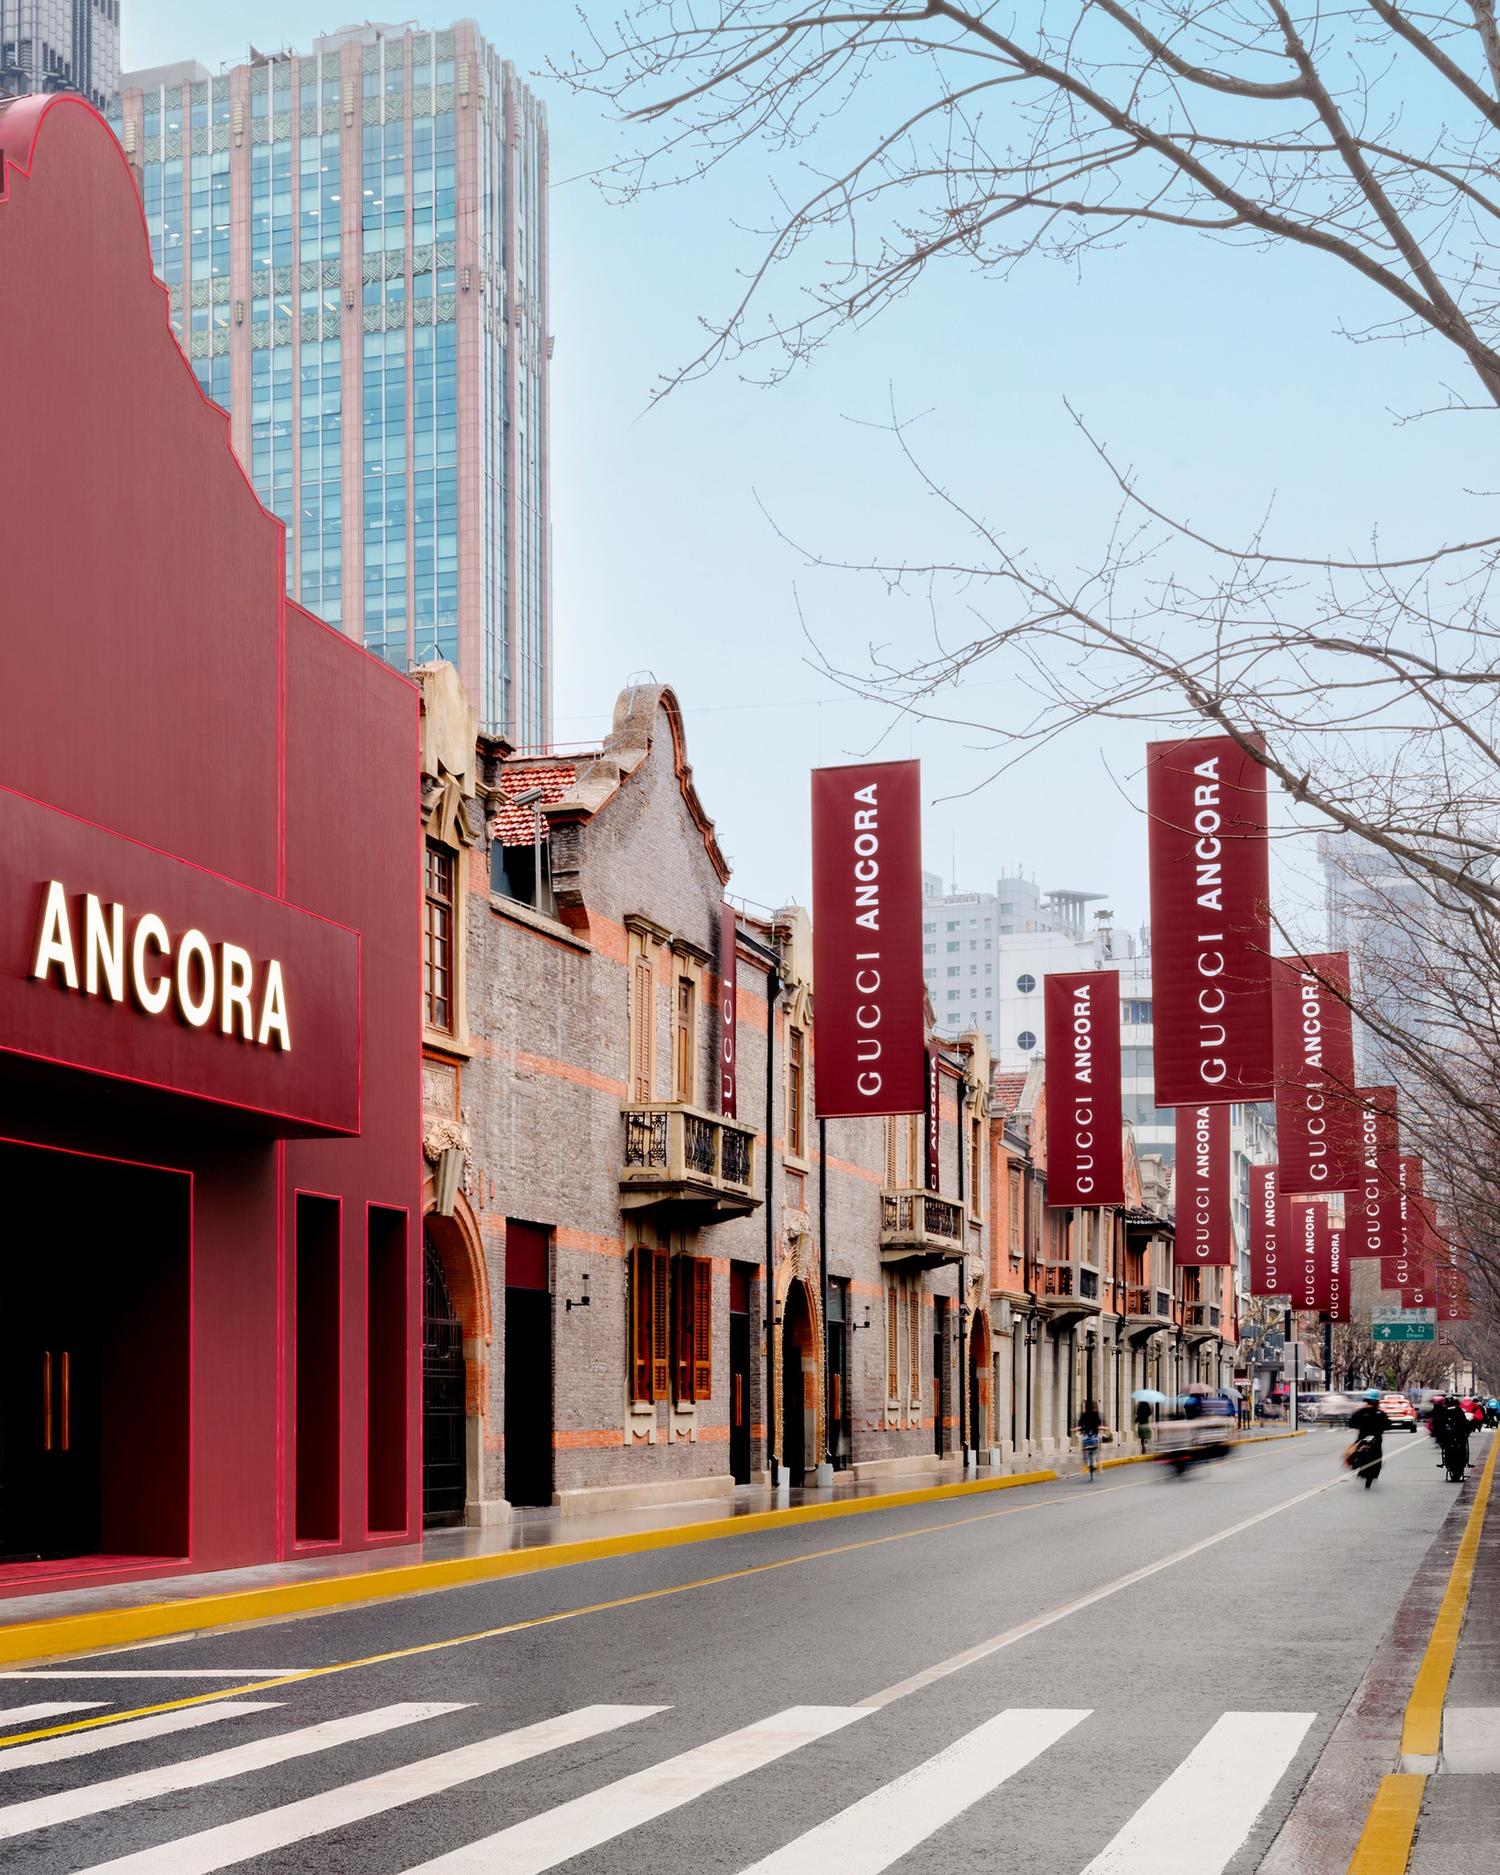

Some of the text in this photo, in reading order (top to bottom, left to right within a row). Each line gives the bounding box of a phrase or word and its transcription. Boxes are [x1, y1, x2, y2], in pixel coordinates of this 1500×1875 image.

[34, 880, 291, 1051] ANCORA
[854, 783, 882, 1096] GUCCI ANCORA
[1194, 756, 1227, 1084] GUCCI ANCORA
[723, 979, 733, 1120] UCCI
[1073, 985, 1094, 1193] GUCCI ANCORA
[1196, 1106, 1210, 1257] GUCCI ANCORA
[1306, 1083, 1328, 1181] GUCCI
[1265, 1171, 1277, 1289] GUCCI ANCORA
[1305, 1207, 1315, 1305] GUCCI ANCORA
[1330, 1233, 1340, 1319] GUCCI ANCORA
[1365, 1178, 1381, 1249] GUCCI
[1406, 1324, 1424, 1333] 入口
